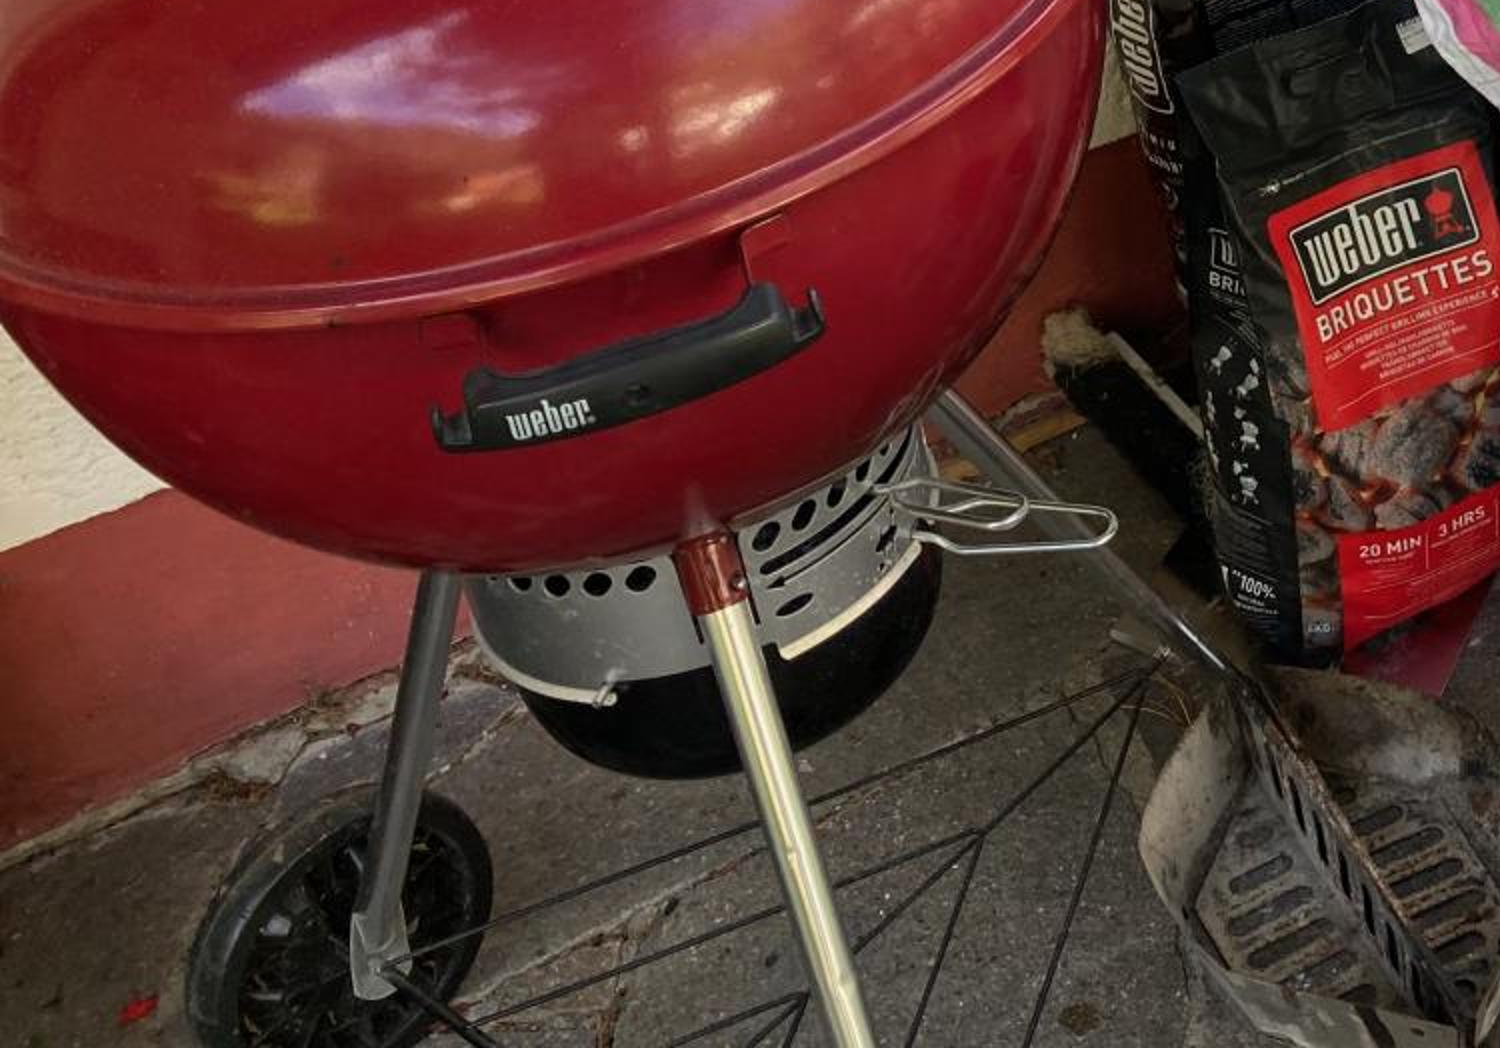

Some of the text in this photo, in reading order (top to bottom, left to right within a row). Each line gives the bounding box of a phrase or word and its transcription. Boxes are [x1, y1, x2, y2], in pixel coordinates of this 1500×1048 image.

[1304, 197, 1421, 288] weber
[1316, 250, 1492, 343] BRIQUETTES
[505, 398, 596, 442] weber
[1439, 523, 1448, 537] 3
[1451, 505, 1486, 531] HRS
[1360, 535, 1421, 558] 20 MIN
